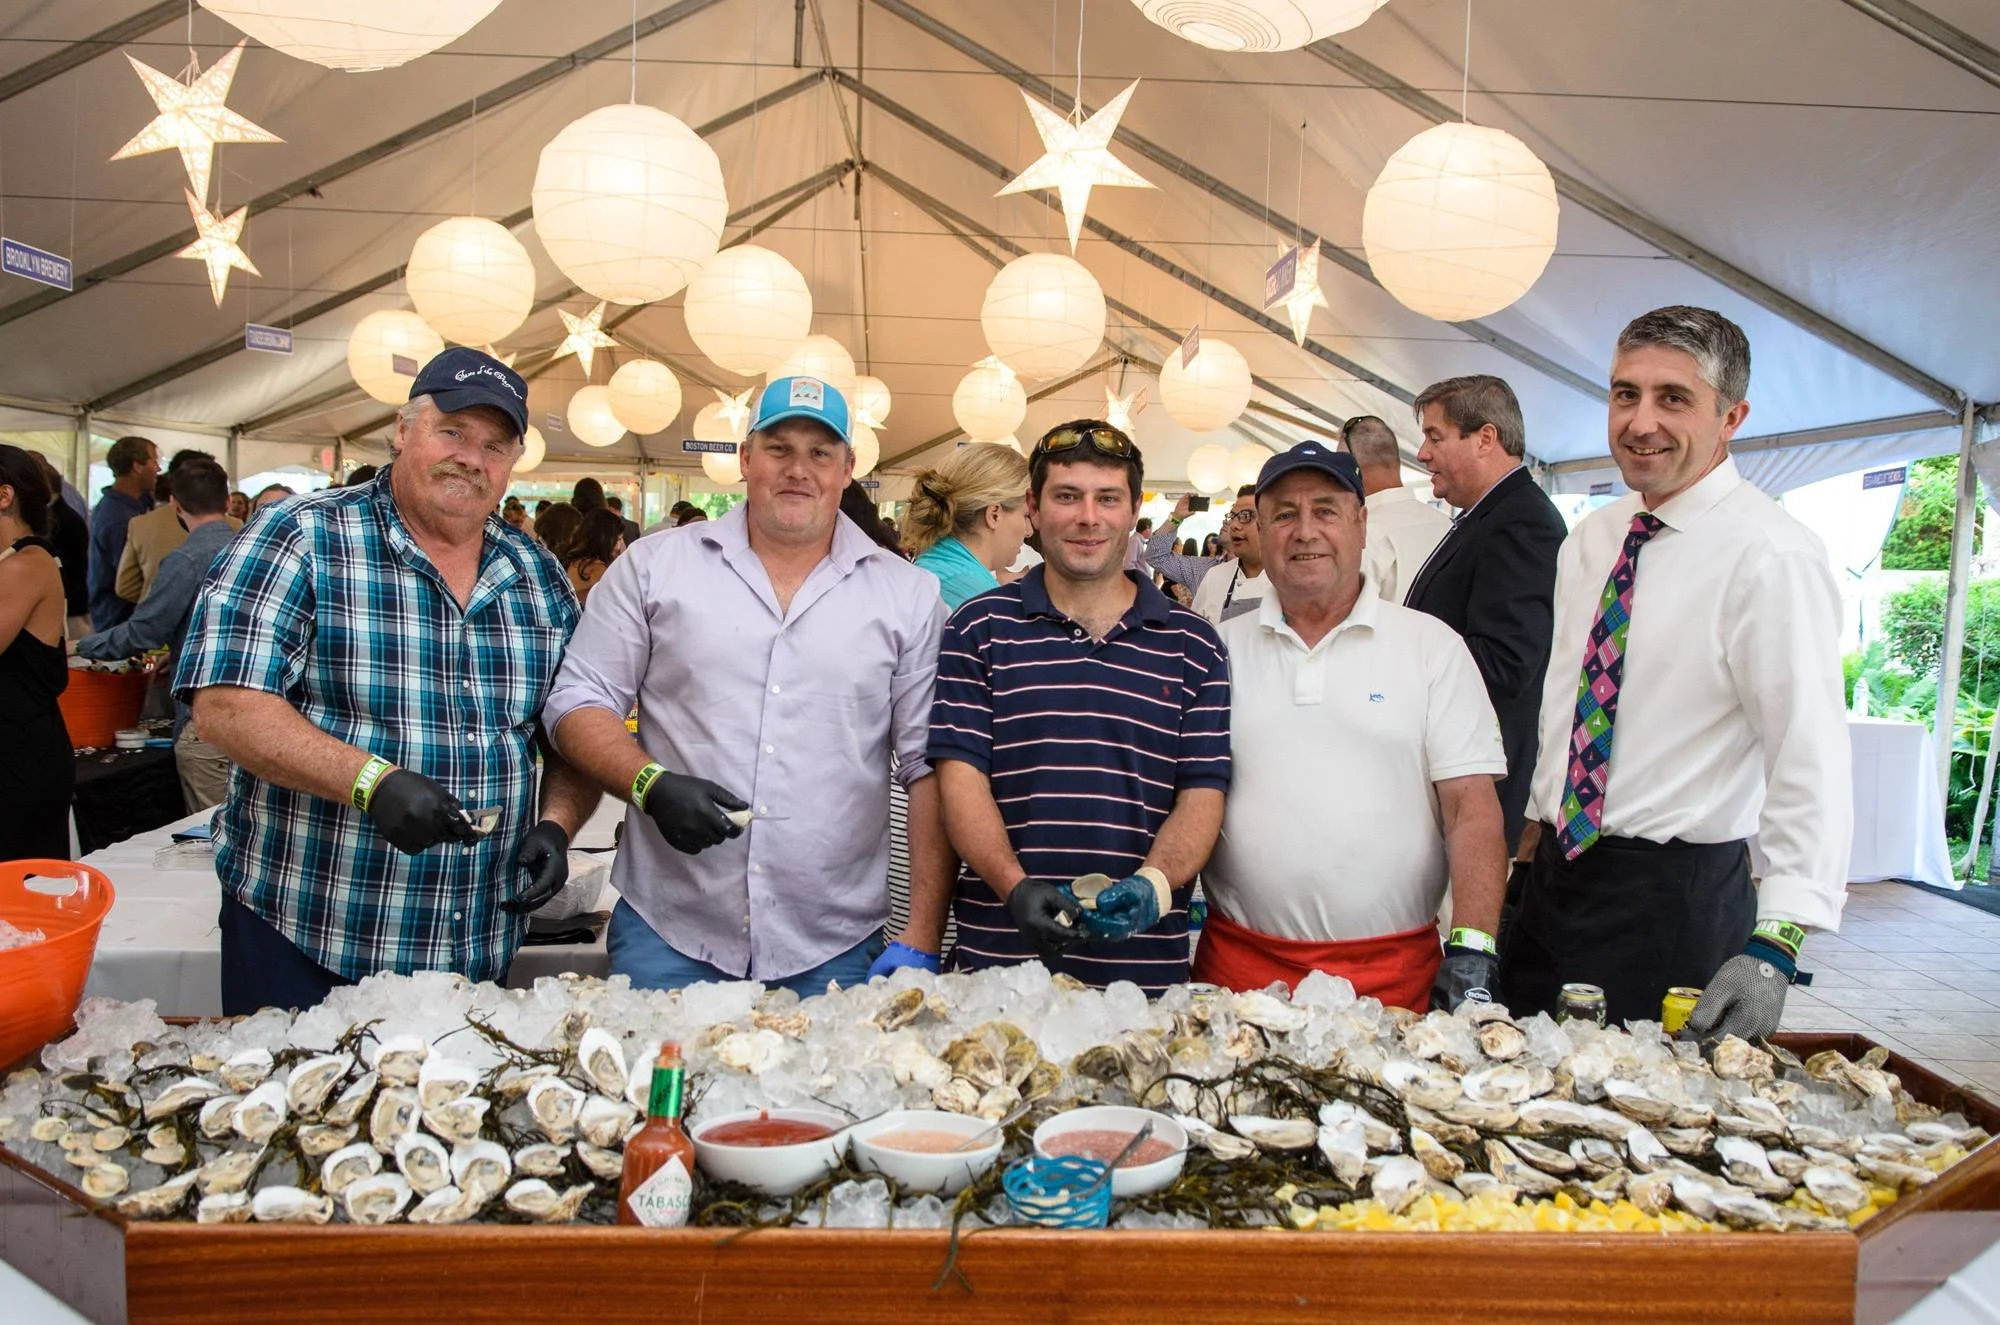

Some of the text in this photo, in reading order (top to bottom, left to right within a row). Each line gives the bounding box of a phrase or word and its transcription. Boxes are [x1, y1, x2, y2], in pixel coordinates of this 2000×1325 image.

[5, 246, 68, 283] BROOKLYN BREWERY
[685, 441, 708, 451] BOSTON
[709, 443, 724, 452] BEER
[357, 761, 380, 789] VIP
[636, 766, 657, 793] VIP
[1778, 926, 1804, 949] VIP
[637, 1192, 691, 1209] TABASC
